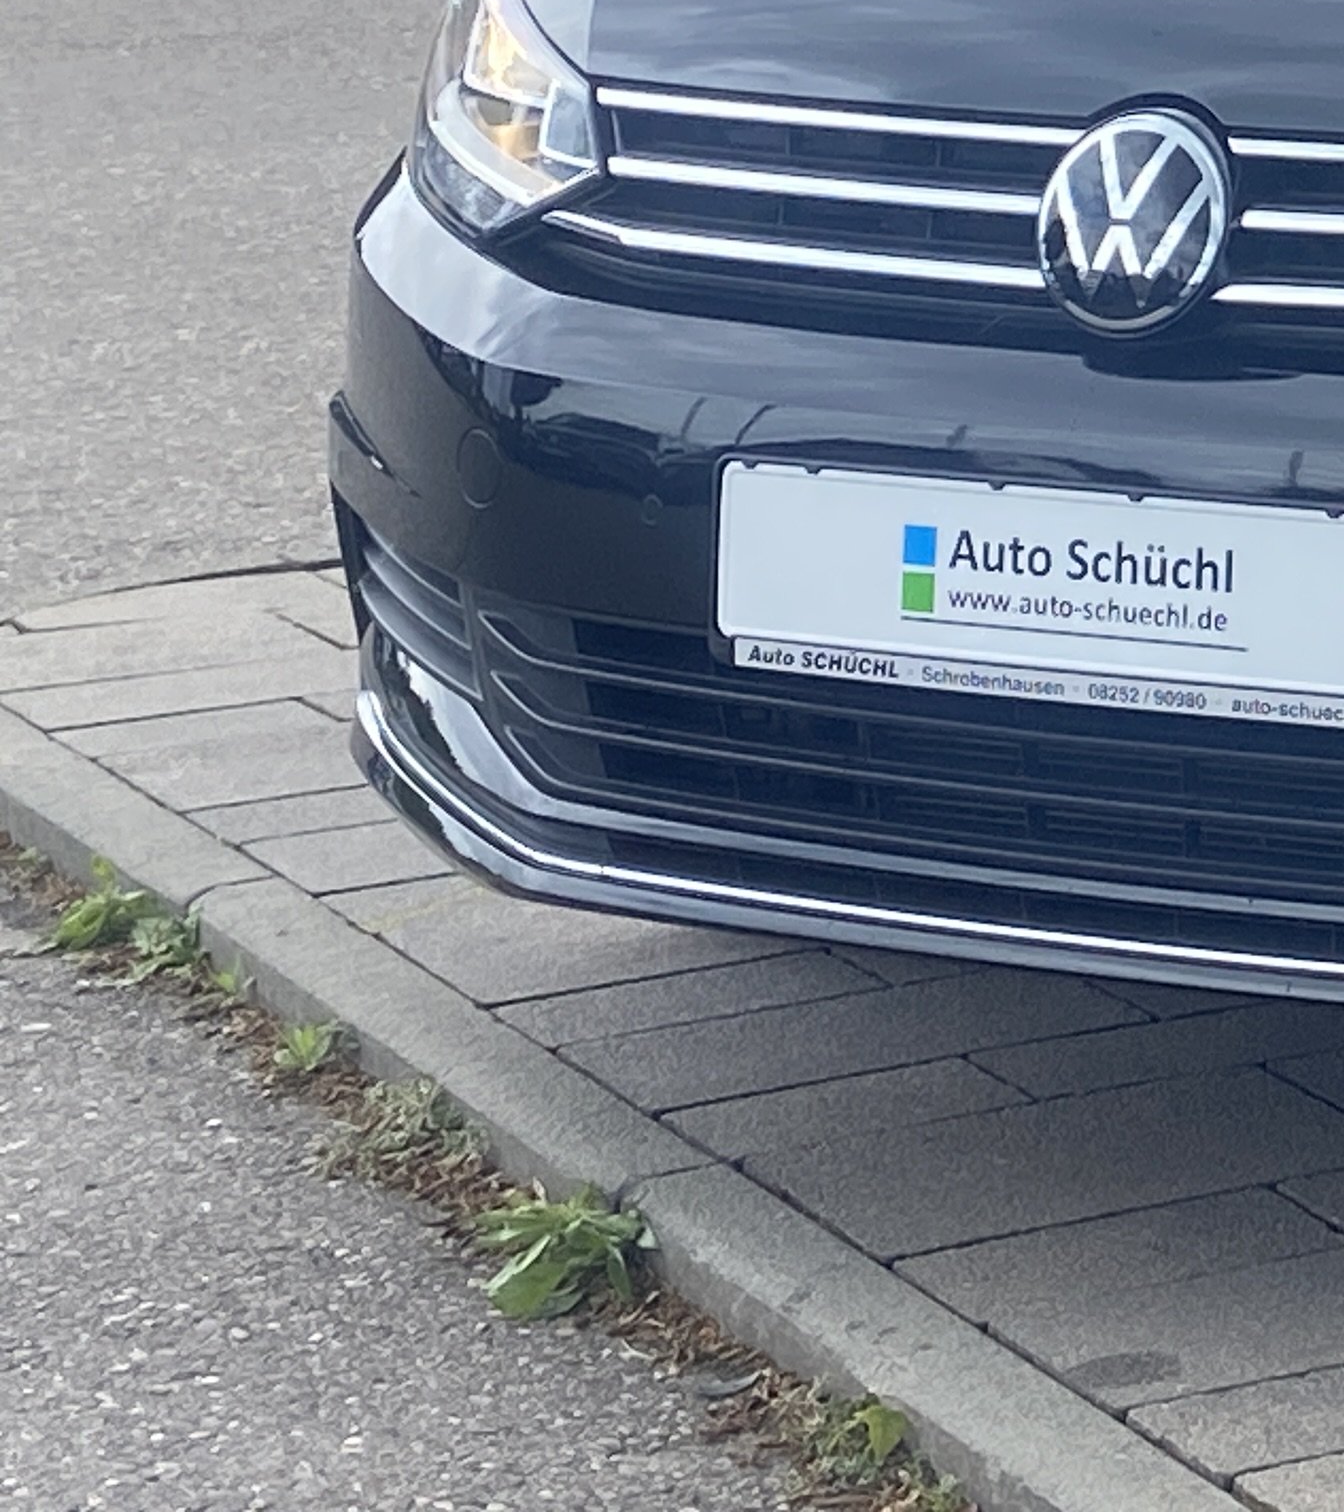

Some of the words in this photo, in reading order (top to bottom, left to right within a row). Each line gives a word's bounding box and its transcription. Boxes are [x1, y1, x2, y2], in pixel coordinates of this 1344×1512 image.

[948, 529, 1052, 577] Auto
[1065, 538, 1234, 593] Schüchl
[948, 589, 1229, 632] www.auto-schuechl.de
[747, 644, 796, 667] Auto
[801, 648, 900, 679] SCHÜCHL
[920, 665, 1066, 696] Schrobenhausen
